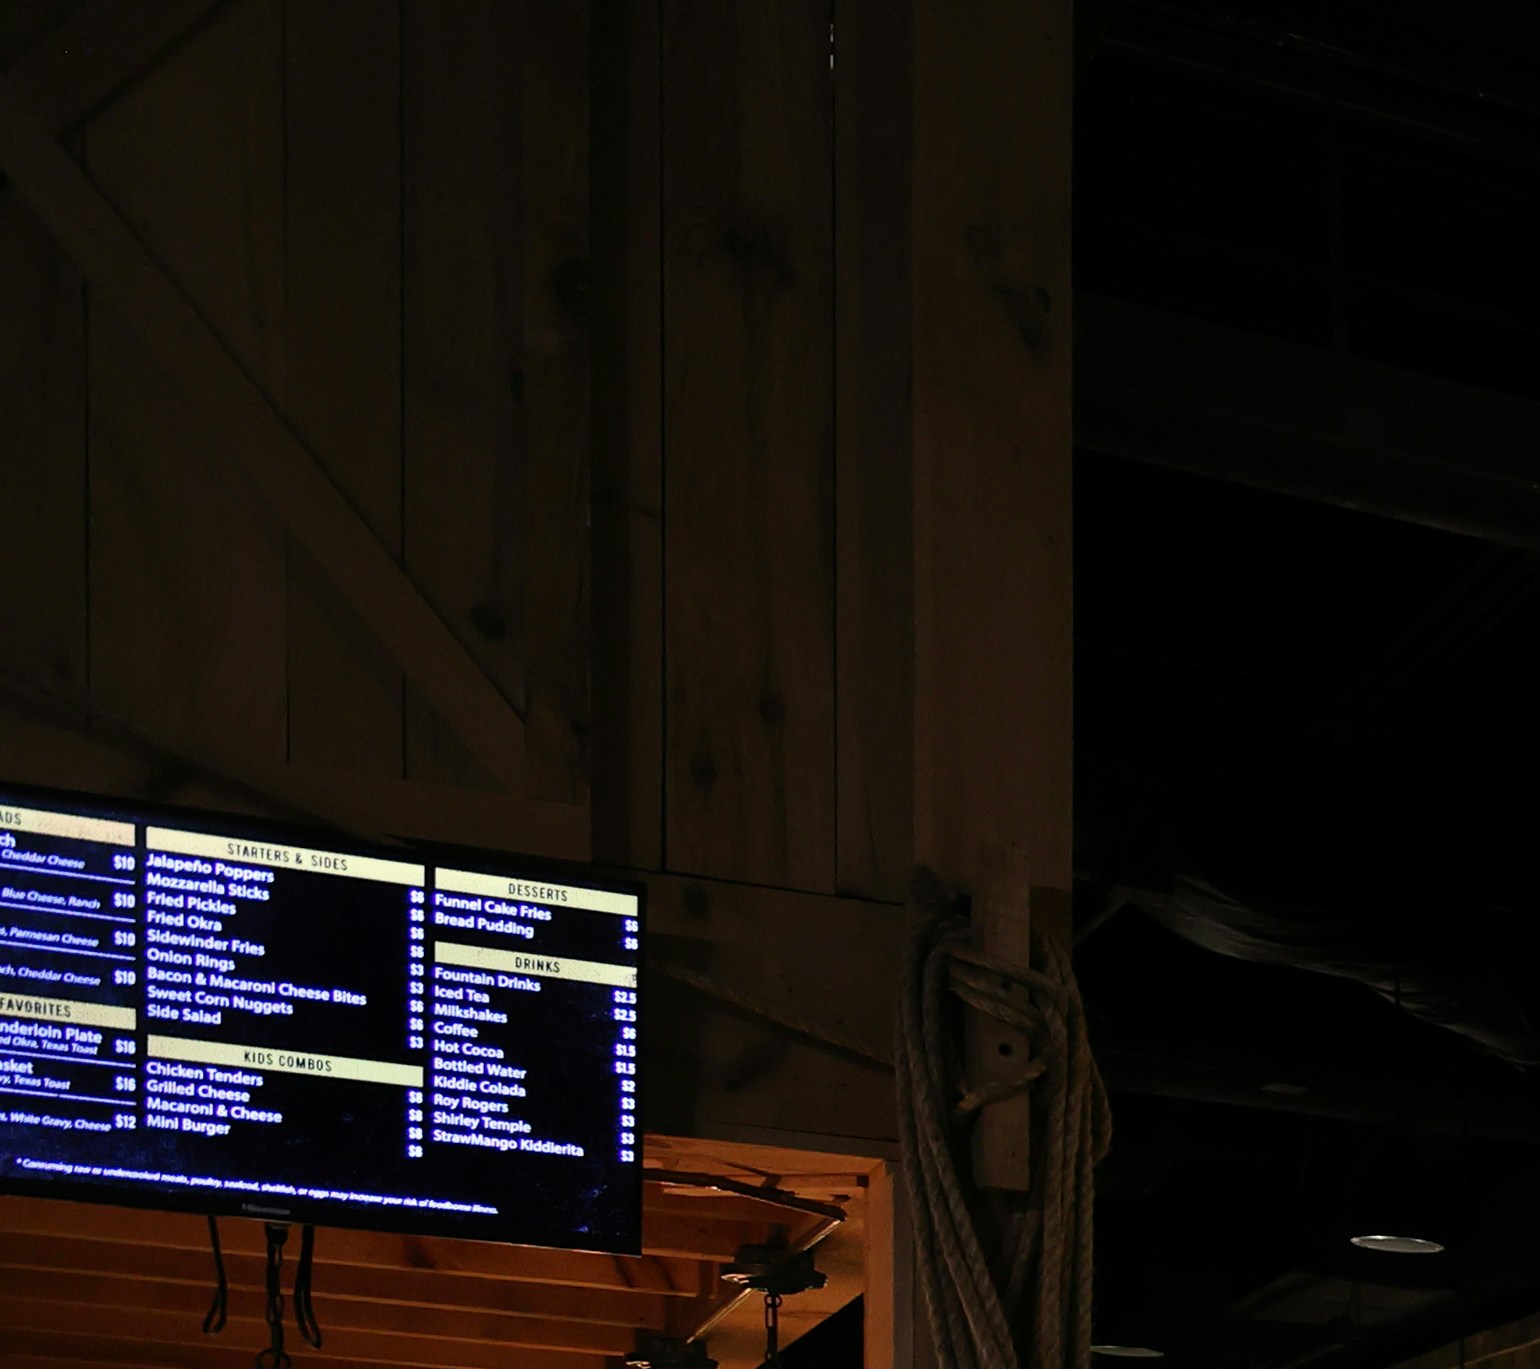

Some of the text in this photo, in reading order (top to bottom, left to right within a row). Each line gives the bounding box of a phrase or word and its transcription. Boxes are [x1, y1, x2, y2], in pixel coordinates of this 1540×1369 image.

[1, 849, 135, 871] Cheddar Cheese $10
[146, 853, 212, 875] Jalapeño
[215, 863, 274, 883] Poppers
[227, 843, 348, 872] STARTERS & SIDES
[146, 872, 225, 896] Mozzarella
[228, 883, 270, 901] Sticks
[508, 883, 568, 902] DESSERTS
[2, 887, 26, 900] Blue
[68, 896, 101, 909] Ranch
[114, 892, 135, 908] $10
[147, 891, 184, 909] Fried
[187, 897, 236, 916] Pickles
[435, 893, 481, 911] Funnel
[484, 900, 518, 915] Cake
[520, 906, 552, 921] Fries
[147, 910, 184, 927] Fried
[187, 915, 222, 933] Okra
[435, 911, 474, 929] Bread
[477, 918, 534, 939] Pudding
[9, 926, 60, 943] Parmesan
[61, 932, 99, 947] Cheese
[114, 930, 136, 947] $10
[147, 929, 229, 951] Sidewinder
[231, 940, 265, 957] Fries
[147, 948, 192, 966] Onion
[195, 953, 235, 972] Rings
[515, 957, 560, 973] DRINKS
[18, 966, 61, 981] Cheddar
[63, 972, 101, 986] Cheese
[114, 969, 136, 985] $10
[147, 966, 192, 985] Bacon
[209, 974, 276, 996] Macaroni
[278, 983, 330, 1002] Cheese
[333, 990, 367, 1007] Bites
[435, 967, 494, 985] Fountain
[498, 975, 541, 992] Drinks
[147, 985, 192, 1003] Sweet
[194, 991, 229, 1008] Corn
[233, 996, 294, 1016] Nuggets
[435, 985, 463, 1000] Iced
[466, 989, 490, 1004] Tea
[147, 1003, 179, 1021] Side
[182, 1008, 222, 1025] Salad
[434, 1003, 508, 1024] Milkshakes
[65, 1028, 103, 1044] Plate
[434, 1022, 479, 1038] Coffee
[116, 1039, 136, 1055] $16
[434, 1039, 460, 1054] Hot
[462, 1043, 504, 1059] Cocoa
[244, 1050, 332, 1072] KIDS COMBOS
[434, 1057, 484, 1074] Bottled
[487, 1064, 527, 1079] Water
[116, 1076, 136, 1092] $16
[146, 1061, 203, 1080] Chicken
[207, 1068, 263, 1086] Tenders
[146, 1079, 195, 1097] Grilled
[198, 1085, 250, 1103] Cheese
[434, 1076, 478, 1091] Kiddie
[480, 1081, 526, 1097] Colada
[147, 1097, 213, 1116] Macaroni
[231, 1105, 282, 1123] Cheese
[434, 1094, 459, 1110] Roy
[462, 1096, 509, 1114] Rogers
[74, 1119, 112, 1132] Cheese
[116, 1114, 136, 1130] $12
[147, 1115, 179, 1130] Mini
[182, 1119, 231, 1137] Burger
[433, 1111, 479, 1129] Shirley
[482, 1117, 531, 1134] Temple
[433, 1129, 518, 1151] StrawMango
[520, 1139, 584, 1157] Kiddierita
